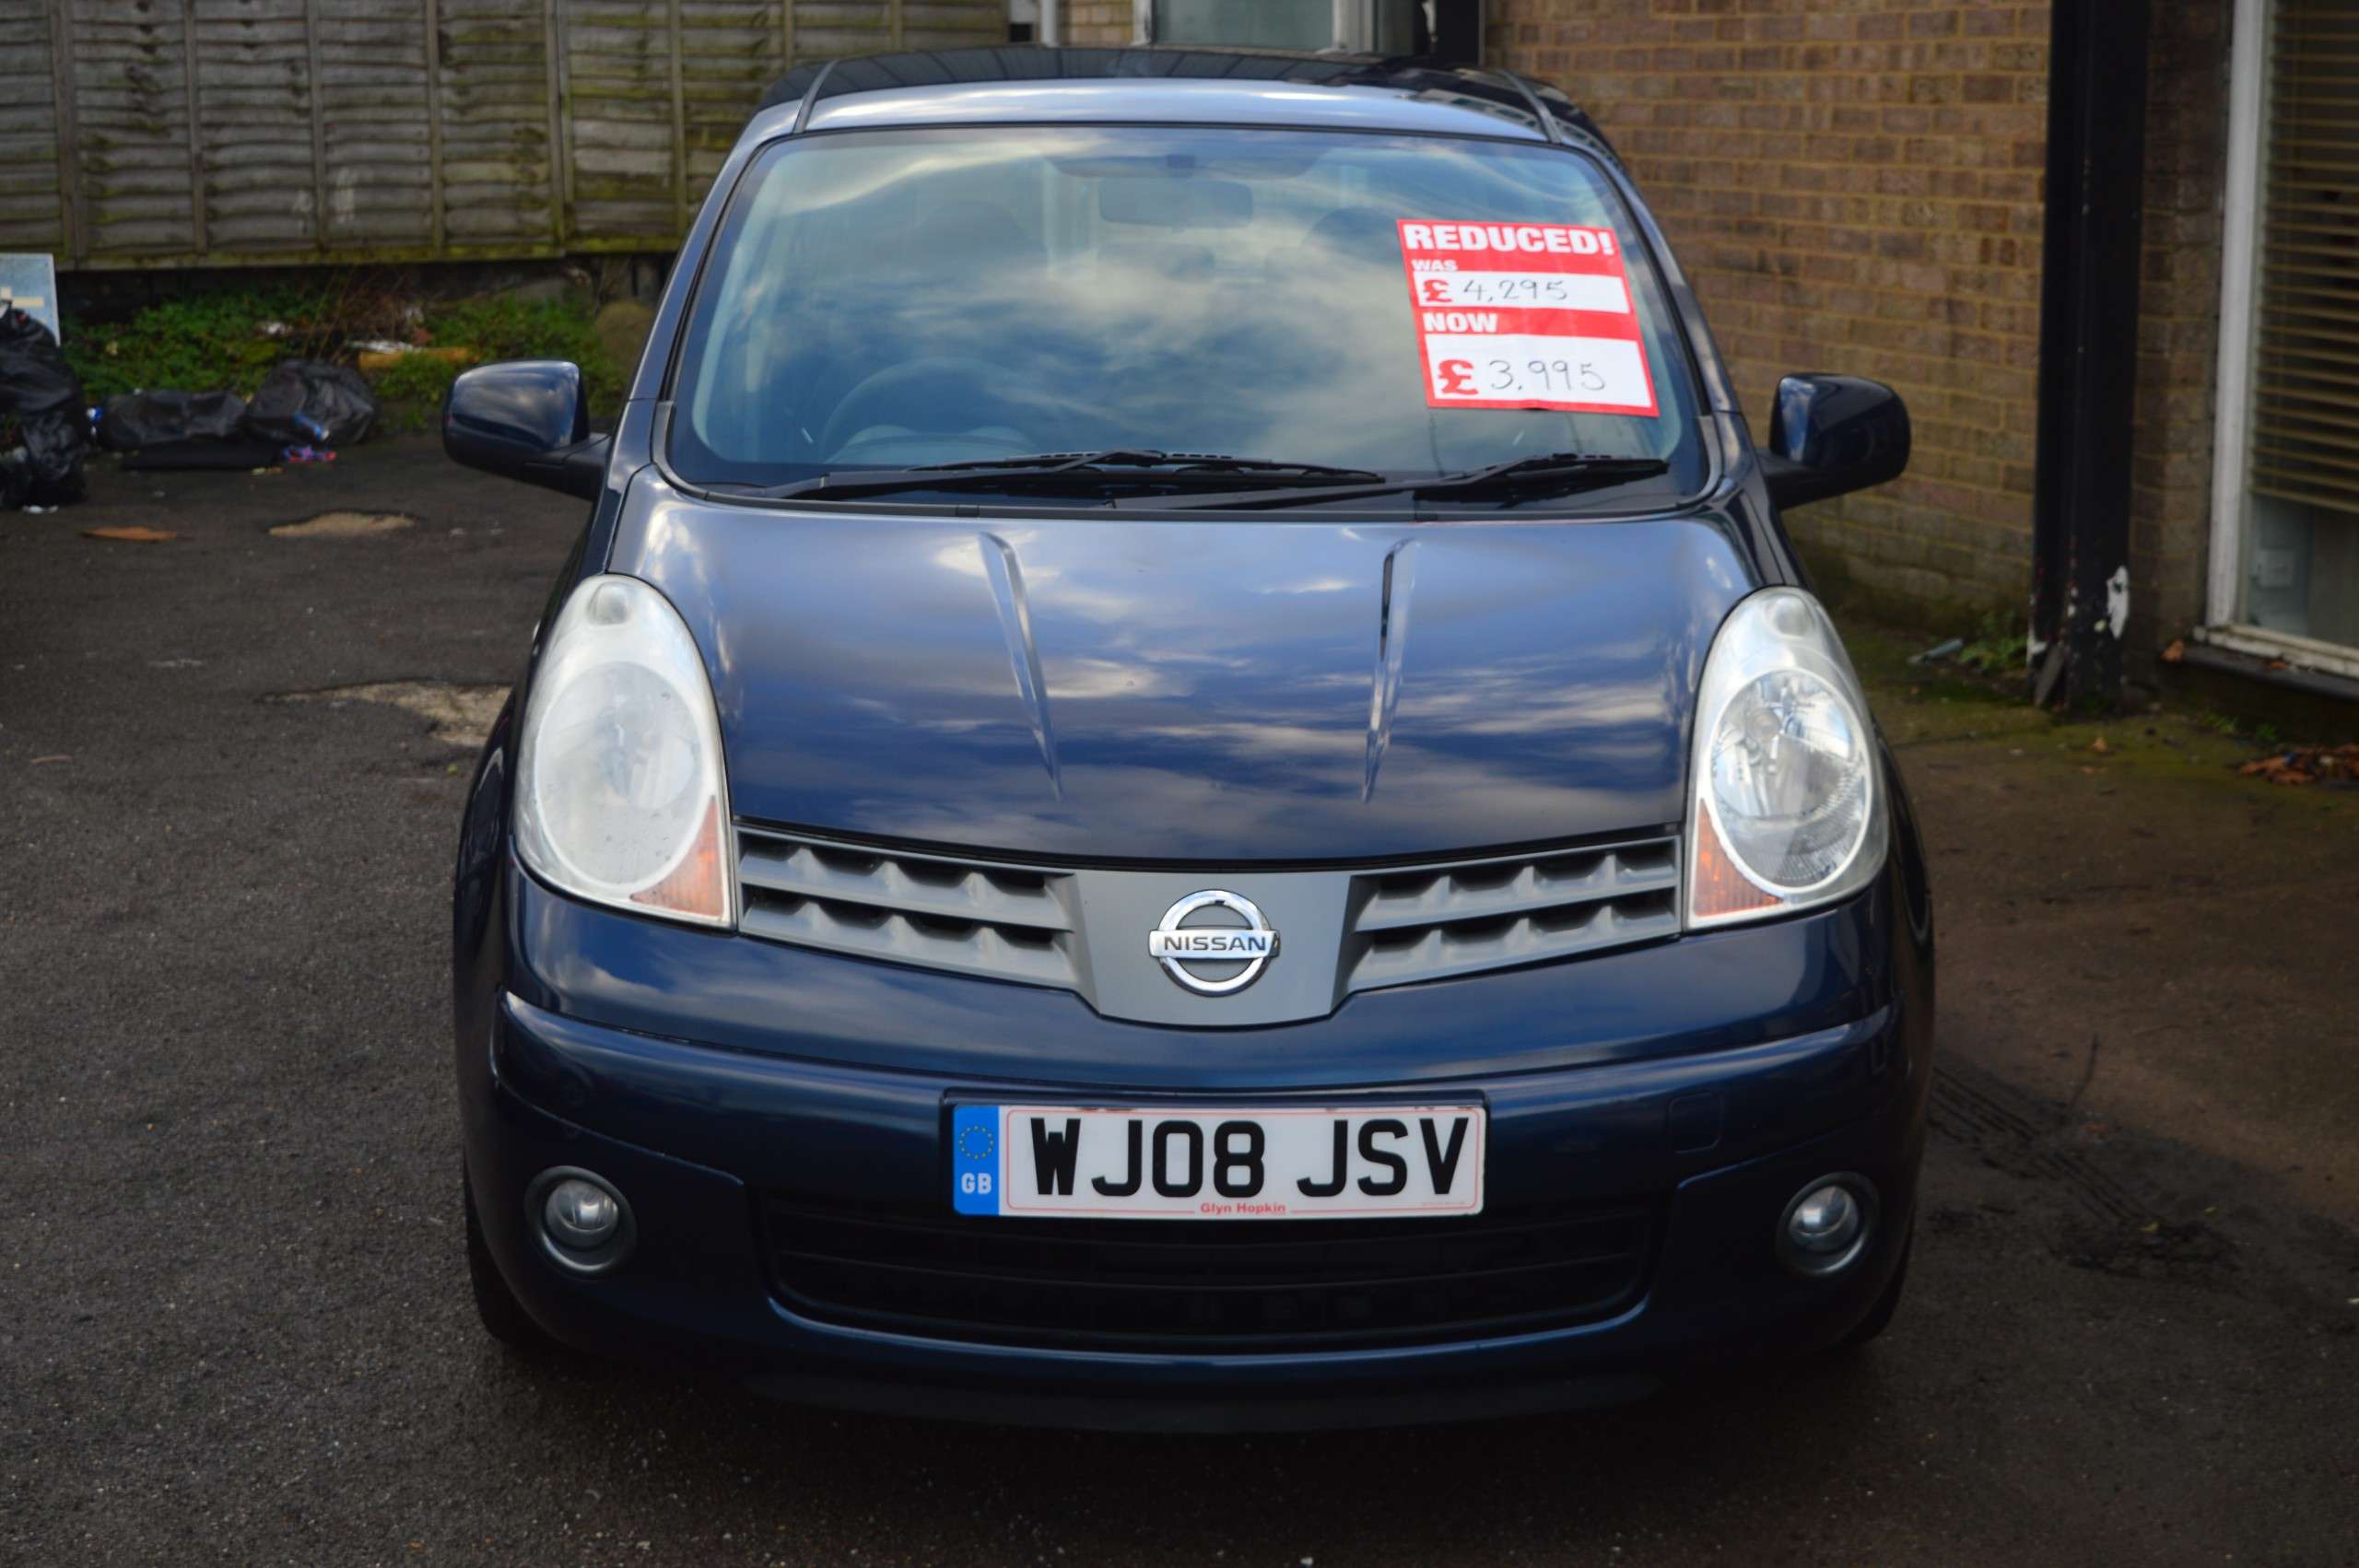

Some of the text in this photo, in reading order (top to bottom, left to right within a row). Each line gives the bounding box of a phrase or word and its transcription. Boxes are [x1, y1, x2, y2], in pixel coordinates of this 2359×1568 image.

[1402, 224, 1614, 254] REDUCED!
[1411, 259, 1458, 271] WAS
[1423, 312, 1498, 333] NOW
[1164, 936, 1265, 951] NISSAN
[1030, 1117, 1470, 1198] WJ08 JSV
[961, 1173, 992, 1194] GB
[1201, 1202, 1285, 1215] Glyn Hopkin
